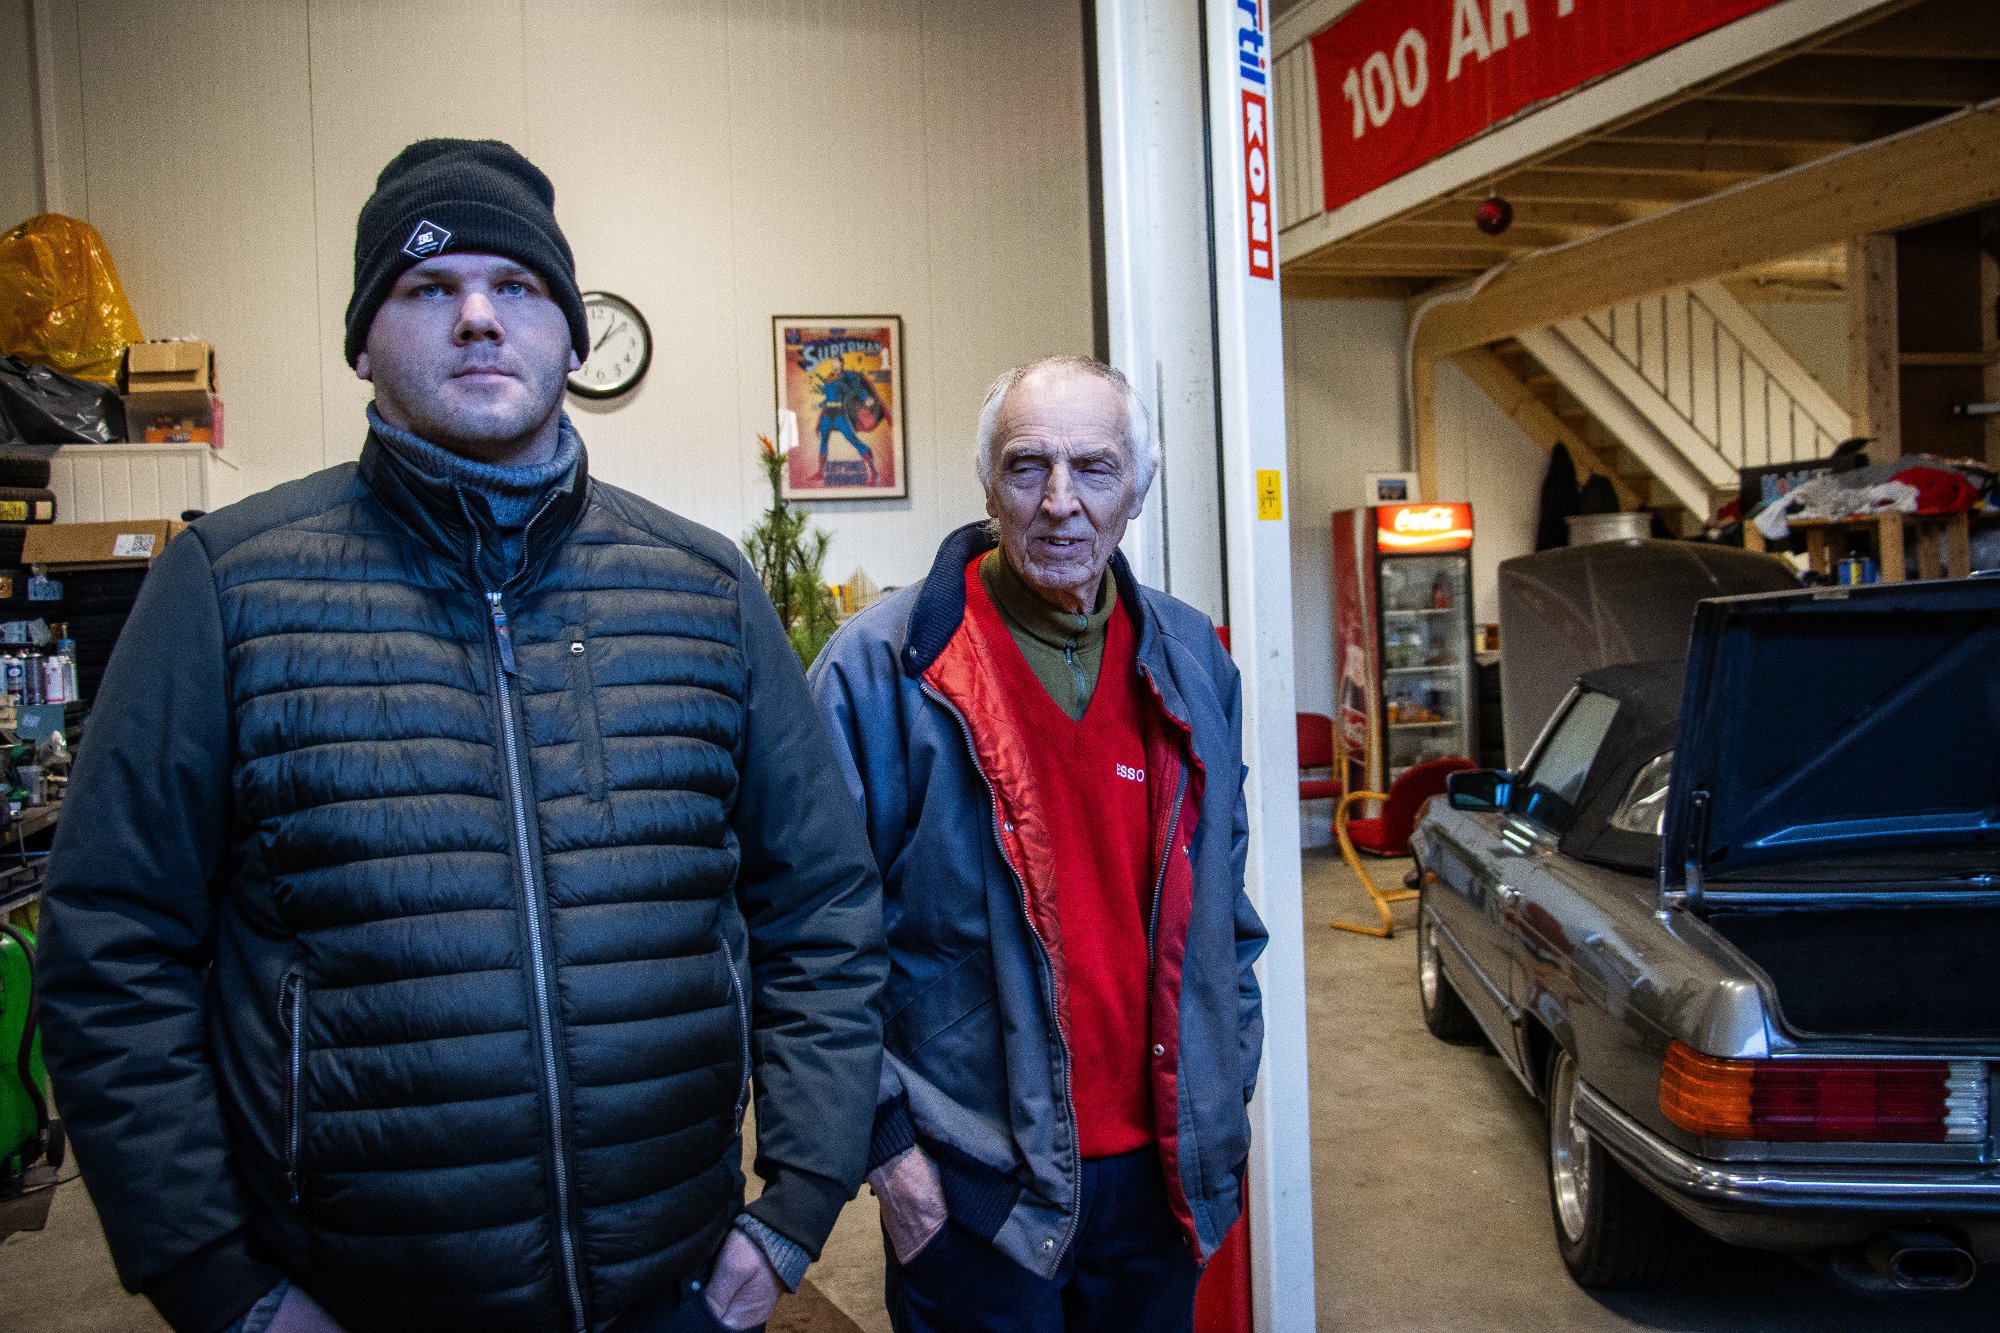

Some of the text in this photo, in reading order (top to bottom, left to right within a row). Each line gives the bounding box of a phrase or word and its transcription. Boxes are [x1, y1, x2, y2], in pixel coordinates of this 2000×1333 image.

[1342, 28, 1429, 140] 100
[1247, 102, 1269, 269] KONI
[803, 340, 881, 372] SUPERMAN
[1116, 763, 1145, 782] ESSO
